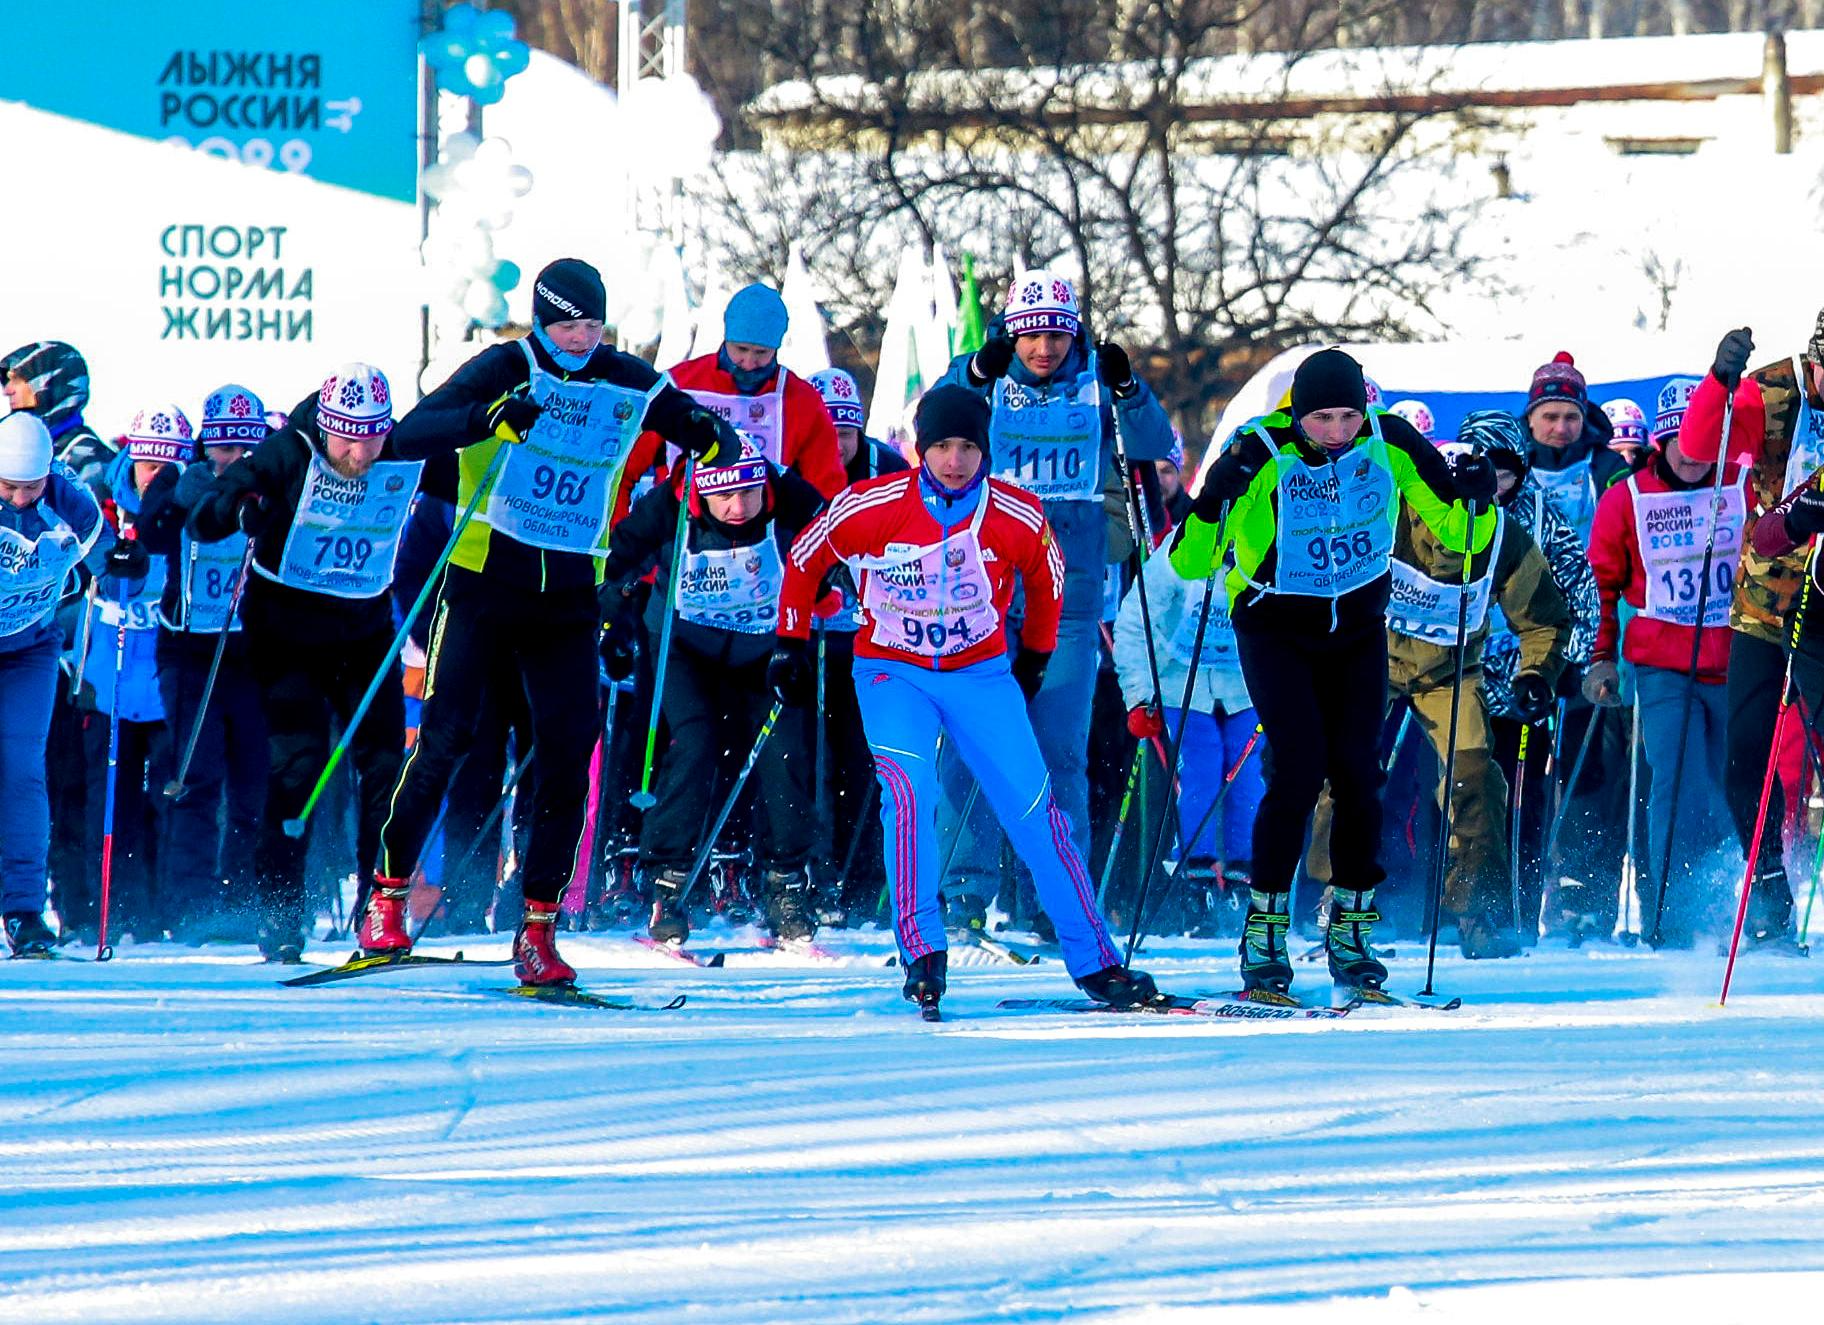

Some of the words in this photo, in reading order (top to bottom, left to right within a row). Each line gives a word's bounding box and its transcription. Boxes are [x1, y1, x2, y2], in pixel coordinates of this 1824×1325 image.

[158, 50, 320, 89] ЛЫЖНЯ
[160, 92, 320, 131] РОССИИ
[160, 223, 287, 260] СПОРТ
[160, 265, 313, 301] НОРМА
[536, 281, 583, 318] NORDSKI
[161, 306, 313, 342] ЖИЗНИ
[1009, 444, 1081, 481] 1110
[312, 485, 367, 506] РОССИИ
[1645, 505, 1692, 522] ЛЫЖНЯ
[522, 518, 570, 538] ОБЛАСТЬ
[1647, 518, 1693, 533] РОССИИ
[1650, 532, 1696, 549] 2022
[313, 535, 373, 572] 799
[1307, 530, 1373, 571] 958
[1393, 591, 1437, 610] ОССИИ
[902, 616, 971, 649] 904
